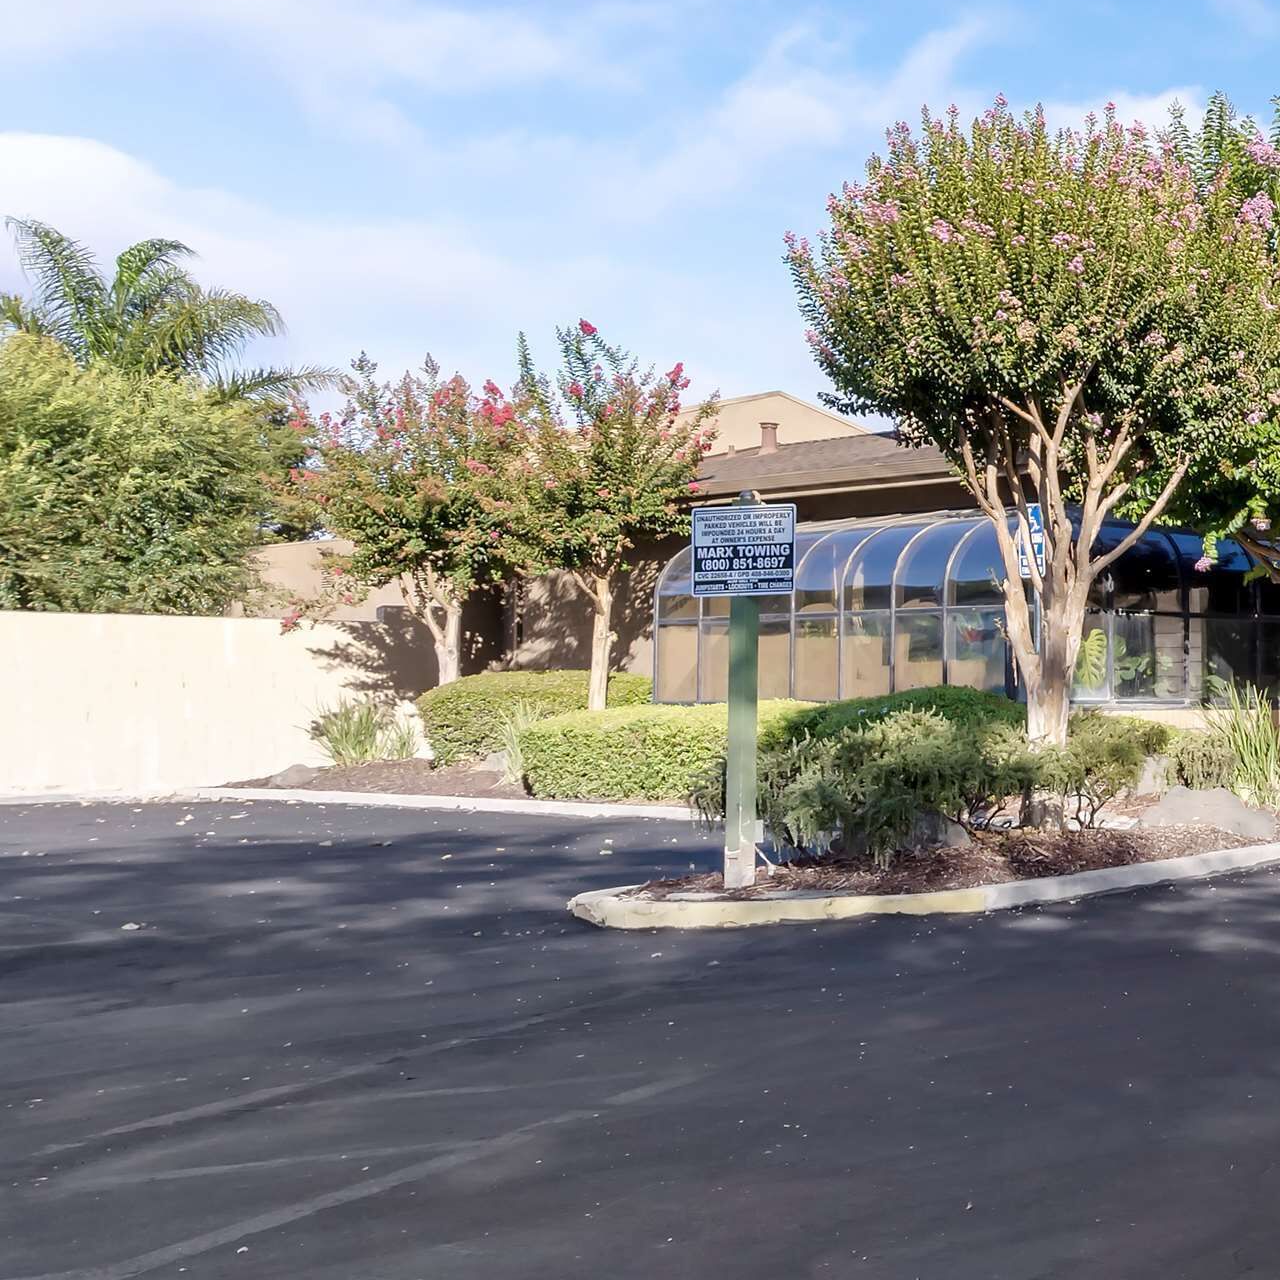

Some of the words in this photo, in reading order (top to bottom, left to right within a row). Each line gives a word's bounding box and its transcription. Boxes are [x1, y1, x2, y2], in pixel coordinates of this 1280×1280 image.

[697, 514, 741, 522] UNAUTHORIZED
[697, 546, 734, 559] MARX
[737, 544, 790, 557] TOWING
[701, 558, 729, 570] (800)
[733, 557, 785, 569] 851-8697
